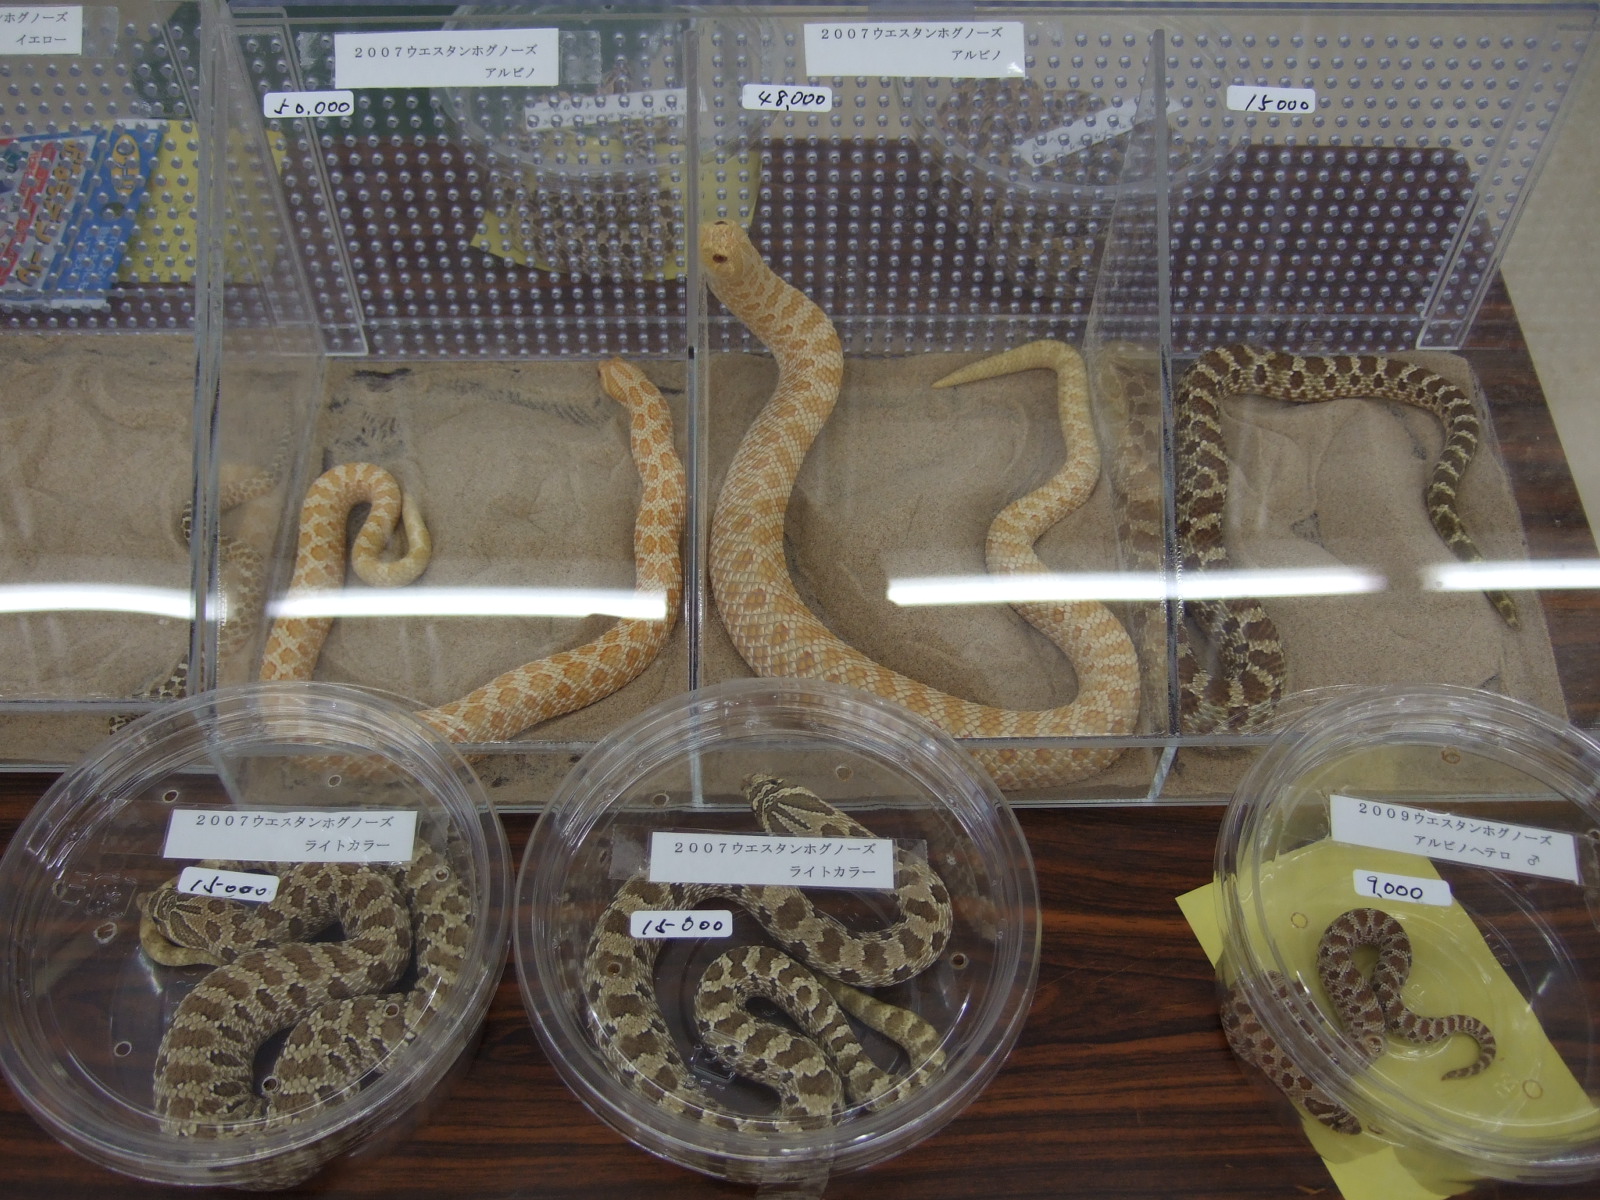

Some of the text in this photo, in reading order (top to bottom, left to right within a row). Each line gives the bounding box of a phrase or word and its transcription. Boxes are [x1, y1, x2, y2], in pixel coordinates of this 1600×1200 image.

[16, 34, 67, 46] イエロー
[820, 25, 1004, 41] 2007ウエスタンホグノーズ
[354, 43, 538, 59] 2007ウエスタンホグノーズ
[758, 90, 826, 111] 48,000
[1245, 94, 1309, 111] 15000
[195, 814, 395, 829] 2007ウエスタンホグノーズ
[1358, 802, 1553, 846] 2009ウエスタンホグノーズ
[304, 838, 391, 853] ライトカラー
[674, 841, 877, 856] 2007ウエスタンホグノーズ
[789, 864, 877, 879] ライトカラー
[1366, 875, 1424, 899] 9,000
